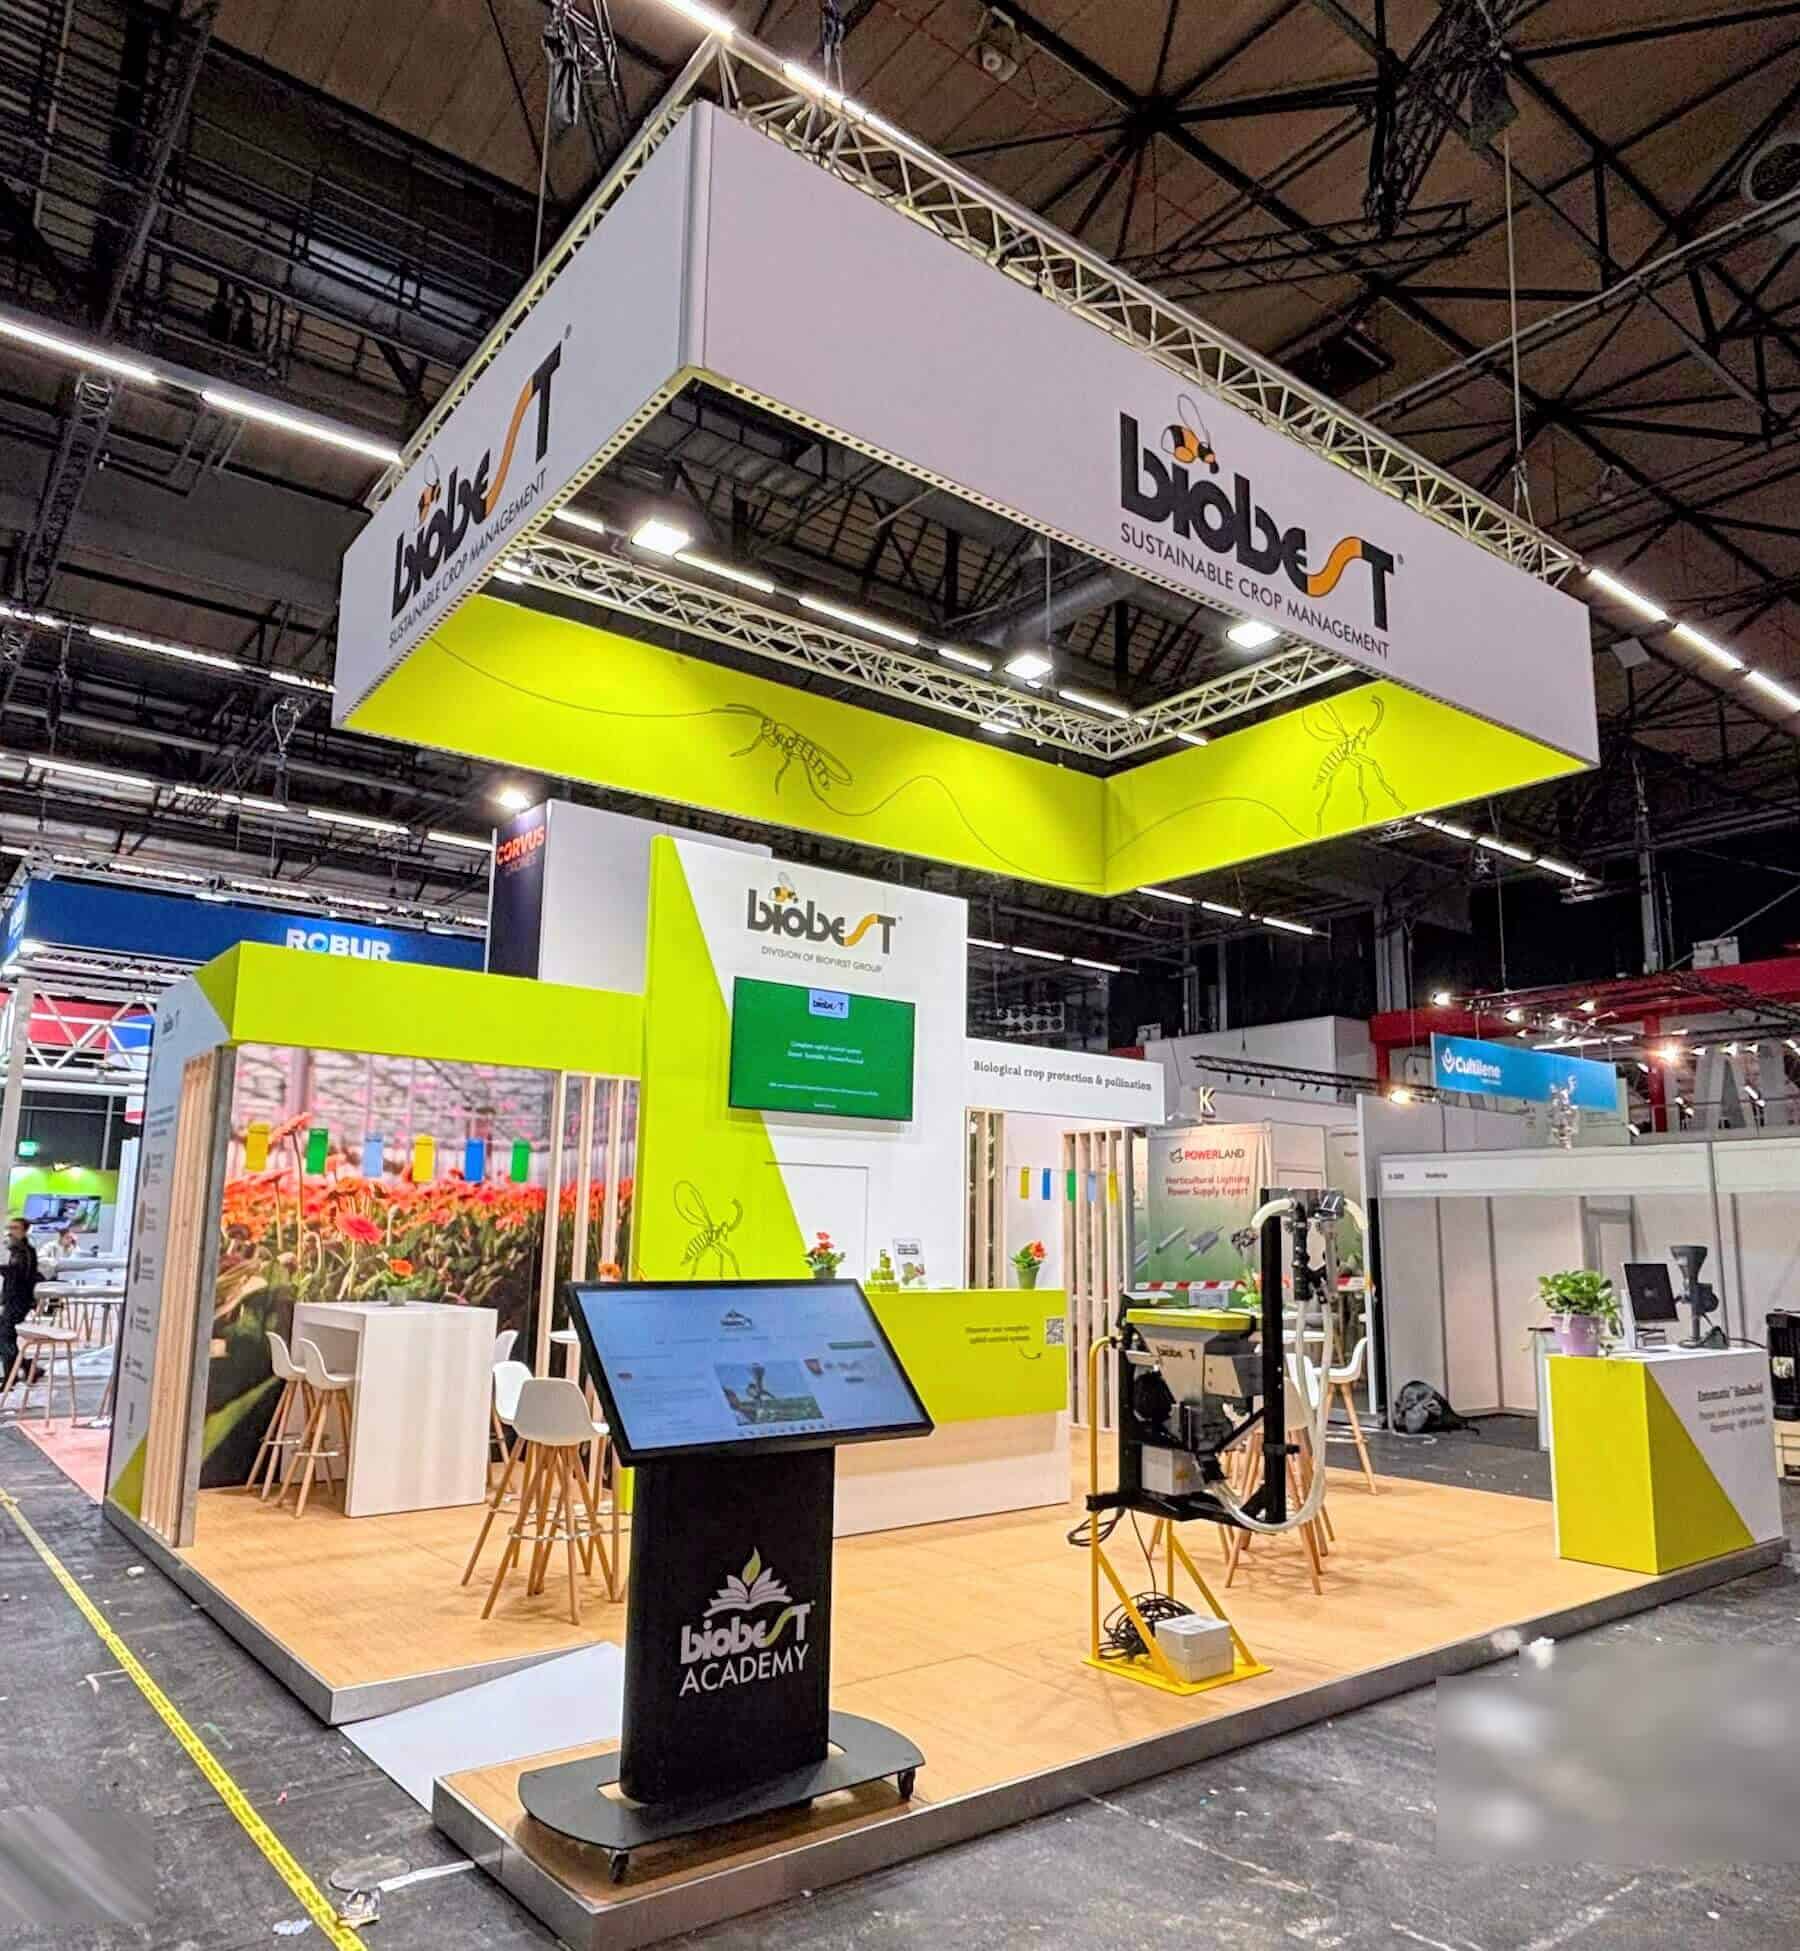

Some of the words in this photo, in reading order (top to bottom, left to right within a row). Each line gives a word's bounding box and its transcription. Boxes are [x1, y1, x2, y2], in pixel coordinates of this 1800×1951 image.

[388, 577, 442, 649] SUSTAINABLE
[442, 555, 470, 592] CROP
[469, 468, 547, 563] MANAGEMENT
[1120, 522, 1234, 591] SUSTAINABLE
[1238, 575, 1282, 611] CROP
[1286, 600, 1391, 660] MANAGEMENT
[496, 825, 545, 865] CORVUS
[286, 928, 391, 961] ROBUR
[761, 945, 801, 961] DIVISION
[802, 951, 814, 963] OF
[853, 960, 883, 974] GROUP
[973, 1060, 1022, 1076] Biological
[1023, 1068, 1045, 1081] crop
[1046, 1071, 1093, 1085] protection
[1095, 1074, 1103, 1086] &
[1105, 1077, 1153, 1092] pollination
[1184, 1148, 1246, 1160] POWERLAND
[1166, 1174, 1216, 1185] Horticultural
[1216, 1174, 1250, 1187] Lighting
[1167, 1186, 1191, 1196] Power
[1191, 1186, 1220, 1199] Supply
[1222, 1186, 1249, 1198] Expert
[678, 1642, 810, 1698] ACADEMY
